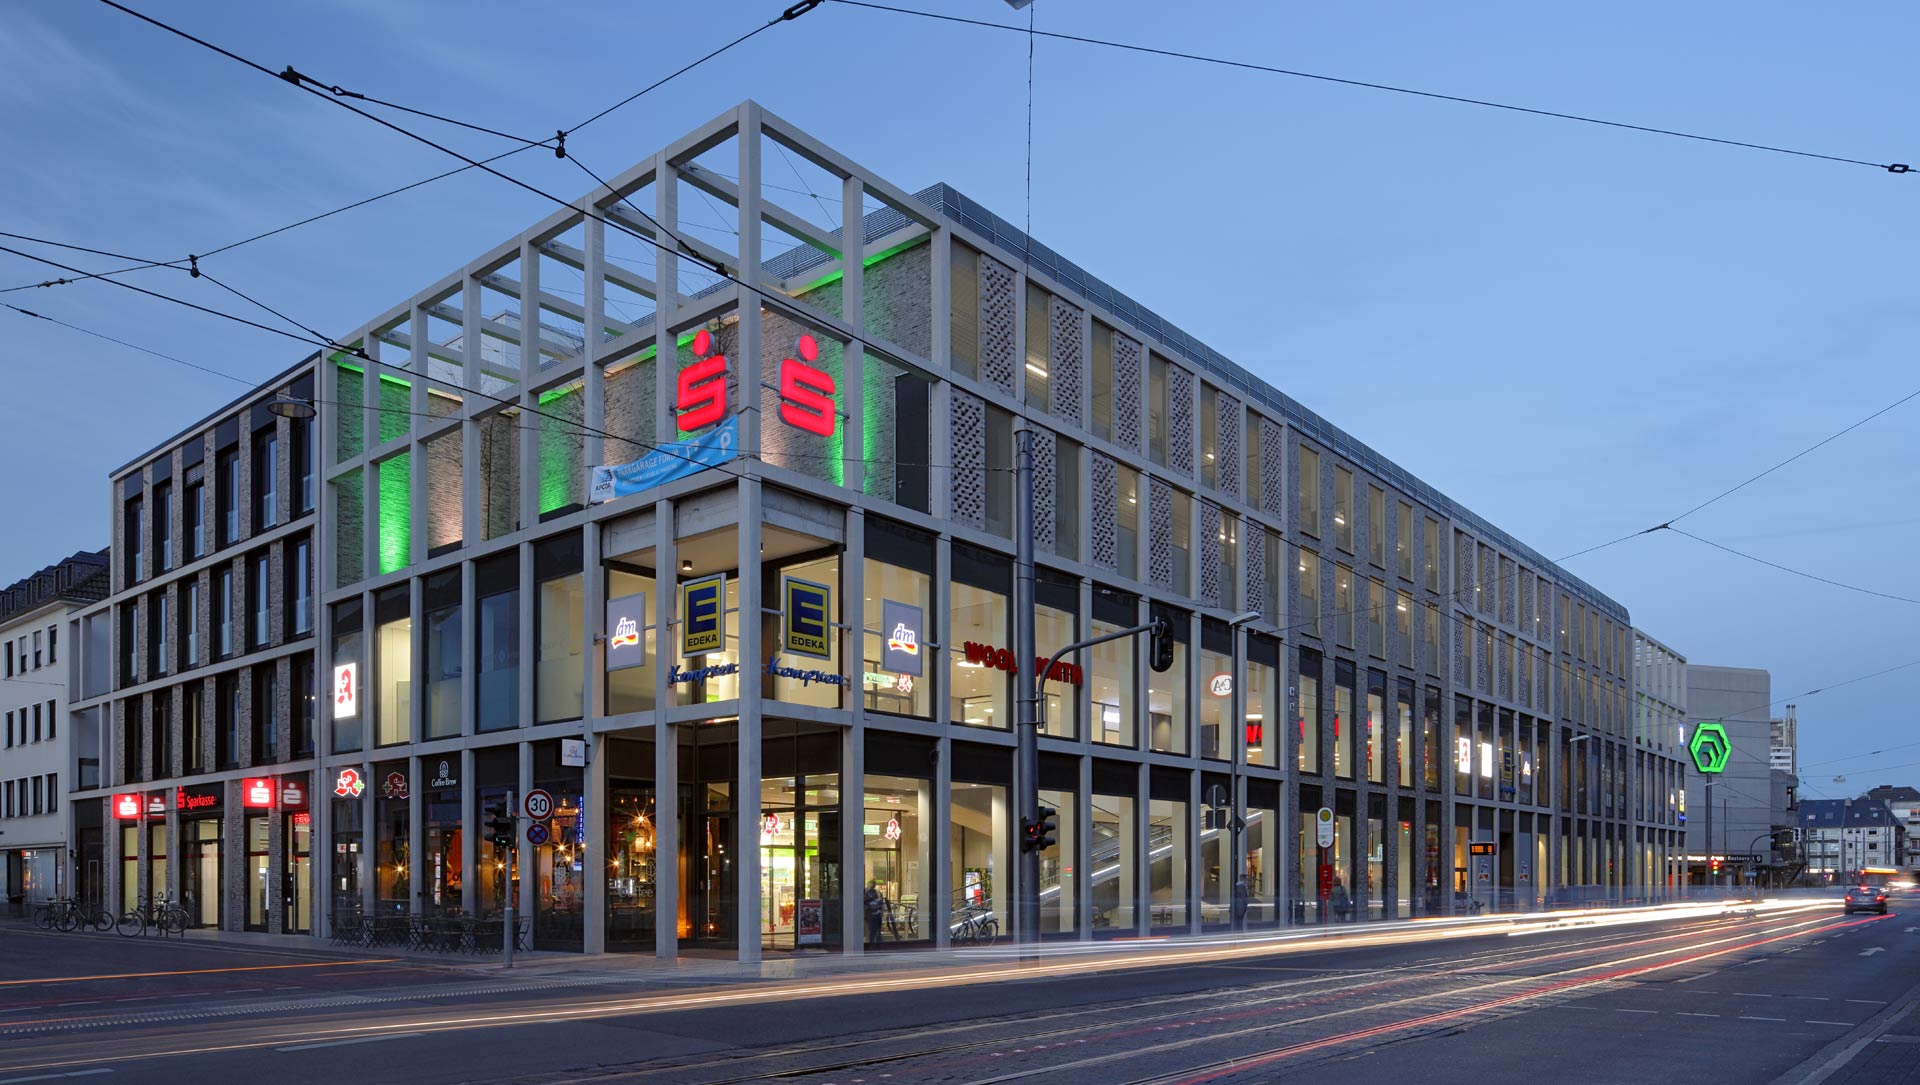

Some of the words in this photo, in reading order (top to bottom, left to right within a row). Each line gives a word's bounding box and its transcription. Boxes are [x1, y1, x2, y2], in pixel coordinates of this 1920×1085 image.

[616, 619, 637, 636] dm
[895, 625, 914, 643] dm
[687, 634, 717, 647] EDEKA
[791, 636, 825, 650] EDEKA
[187, 795, 215, 810] Sparkasse
[530, 797, 547, 812] 30
